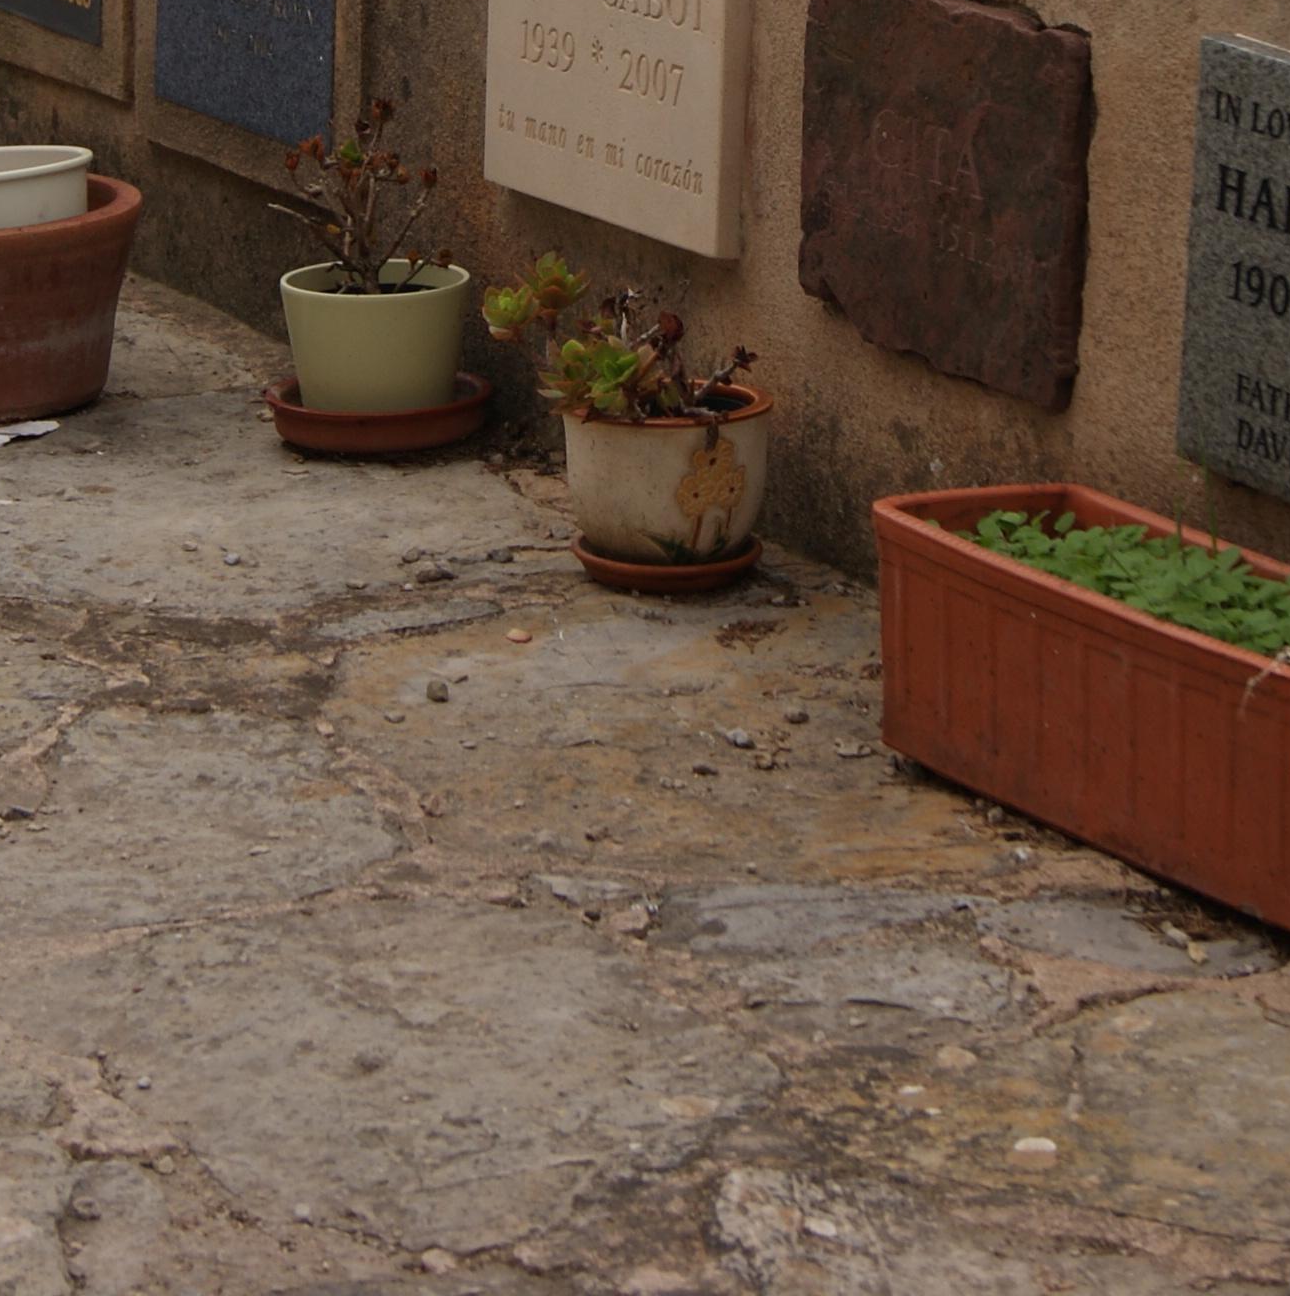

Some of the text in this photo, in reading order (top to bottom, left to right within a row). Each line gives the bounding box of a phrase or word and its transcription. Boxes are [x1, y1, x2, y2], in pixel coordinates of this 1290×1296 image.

[520, 19, 685, 107] 1939 2007
[1212, 88, 1244, 129] IN
[524, 115, 568, 150] mano
[575, 133, 596, 160] en
[604, 136, 625, 170] mi
[635, 152, 704, 196] corazón
